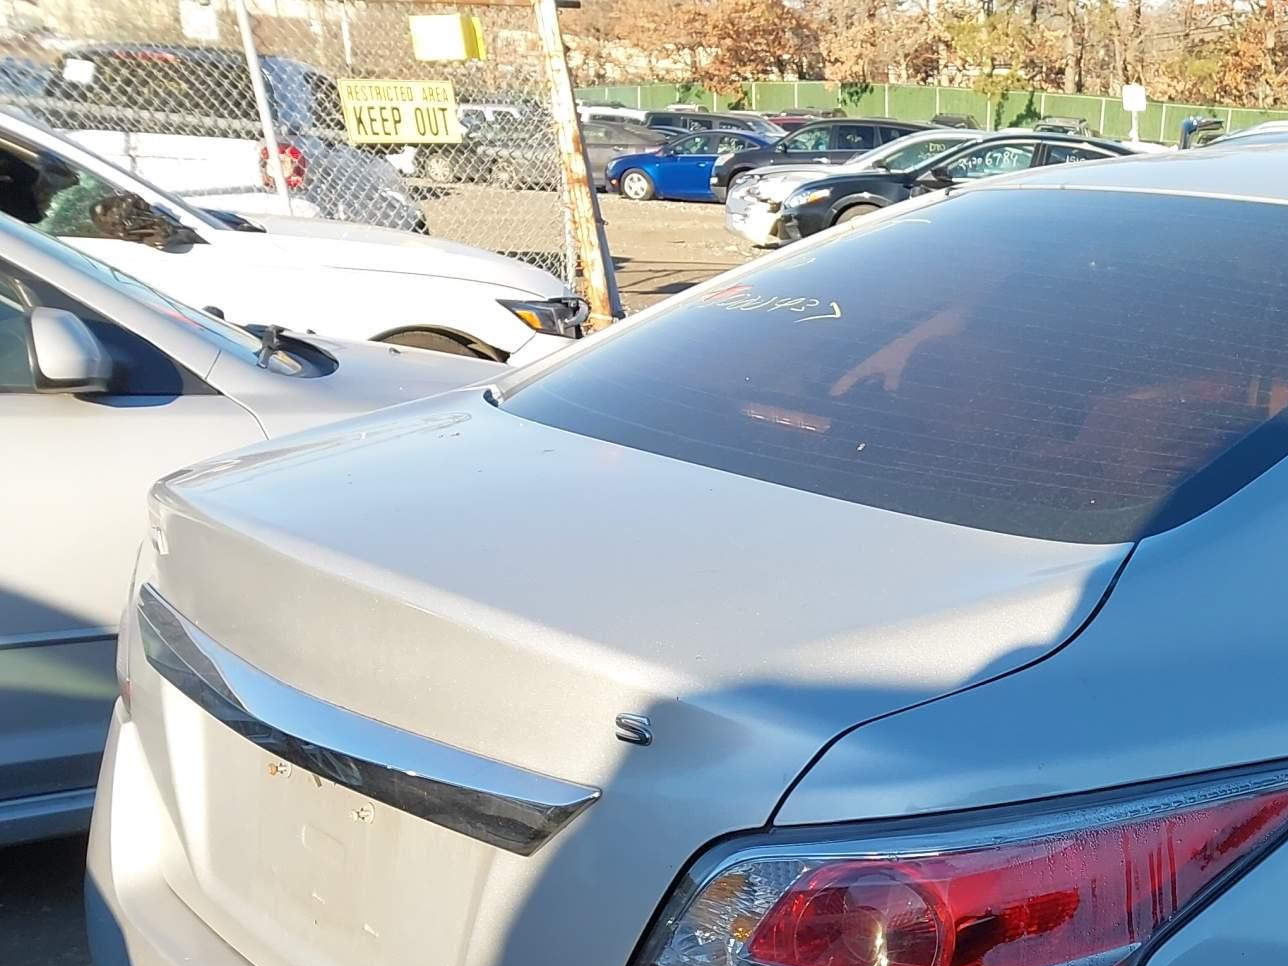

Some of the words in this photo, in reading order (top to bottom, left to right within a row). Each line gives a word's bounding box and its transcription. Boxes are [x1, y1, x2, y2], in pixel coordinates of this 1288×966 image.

[346, 85, 414, 102] RESTRICTED
[422, 86, 449, 103] AREA
[353, 105, 402, 136] KEEP
[414, 106, 449, 137] OUT
[615, 712, 653, 747] S
